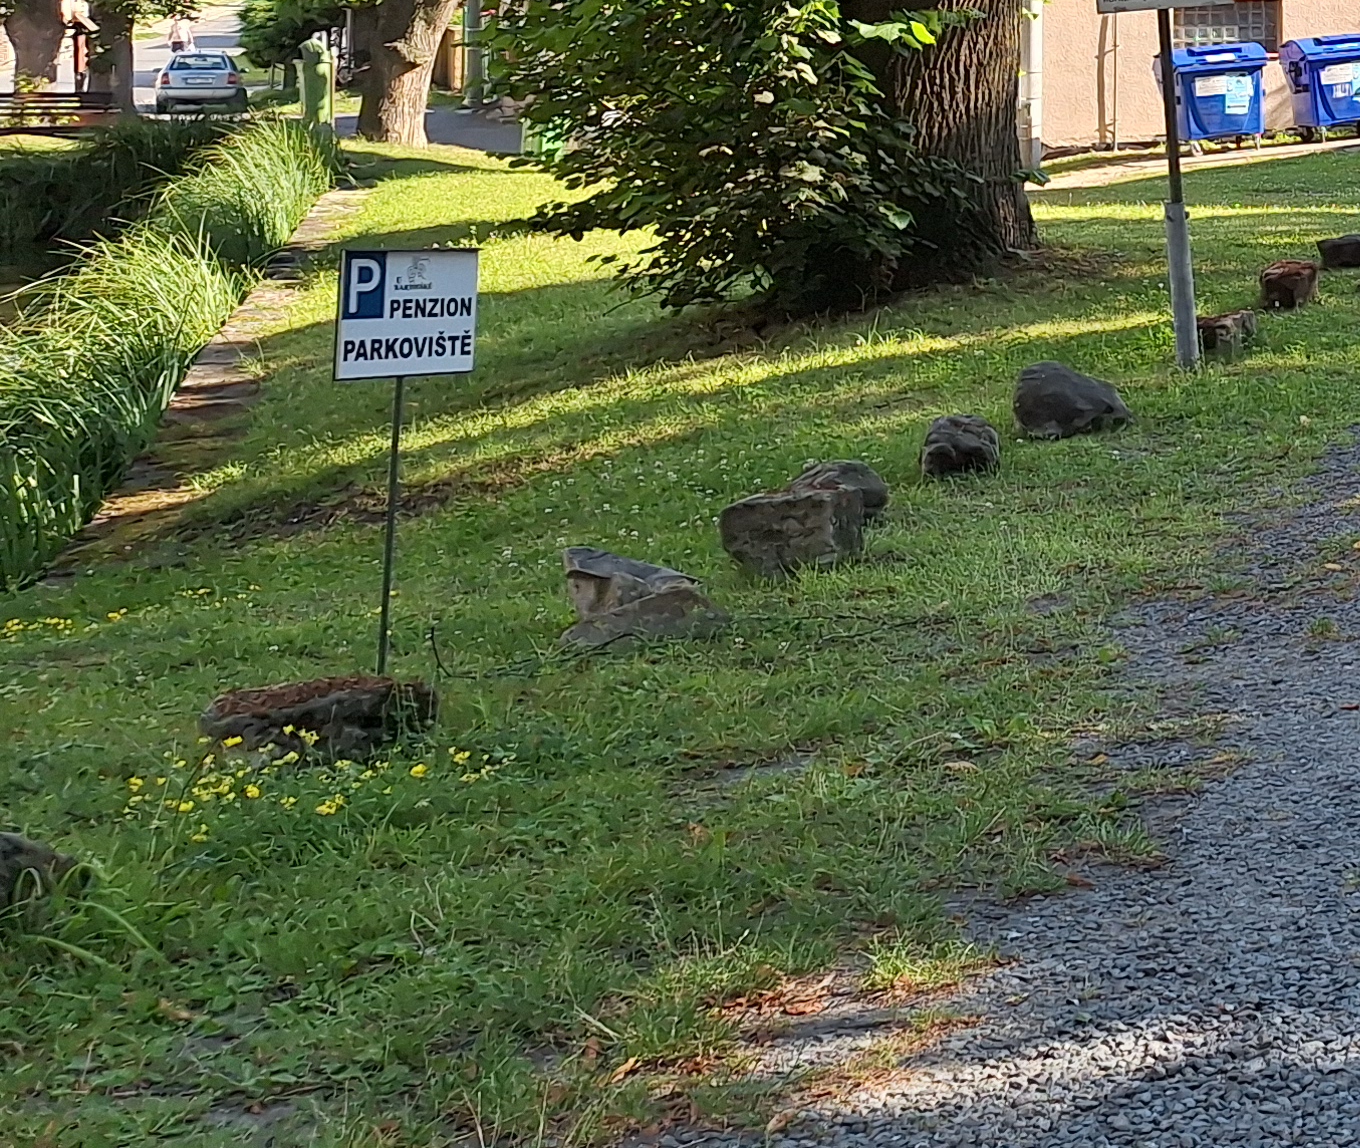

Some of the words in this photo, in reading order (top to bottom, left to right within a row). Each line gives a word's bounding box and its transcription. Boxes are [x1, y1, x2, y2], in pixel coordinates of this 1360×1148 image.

[349, 258, 381, 314] P
[389, 298, 473, 319] PENZION
[343, 330, 472, 362] PARKOVIŠTĚ
